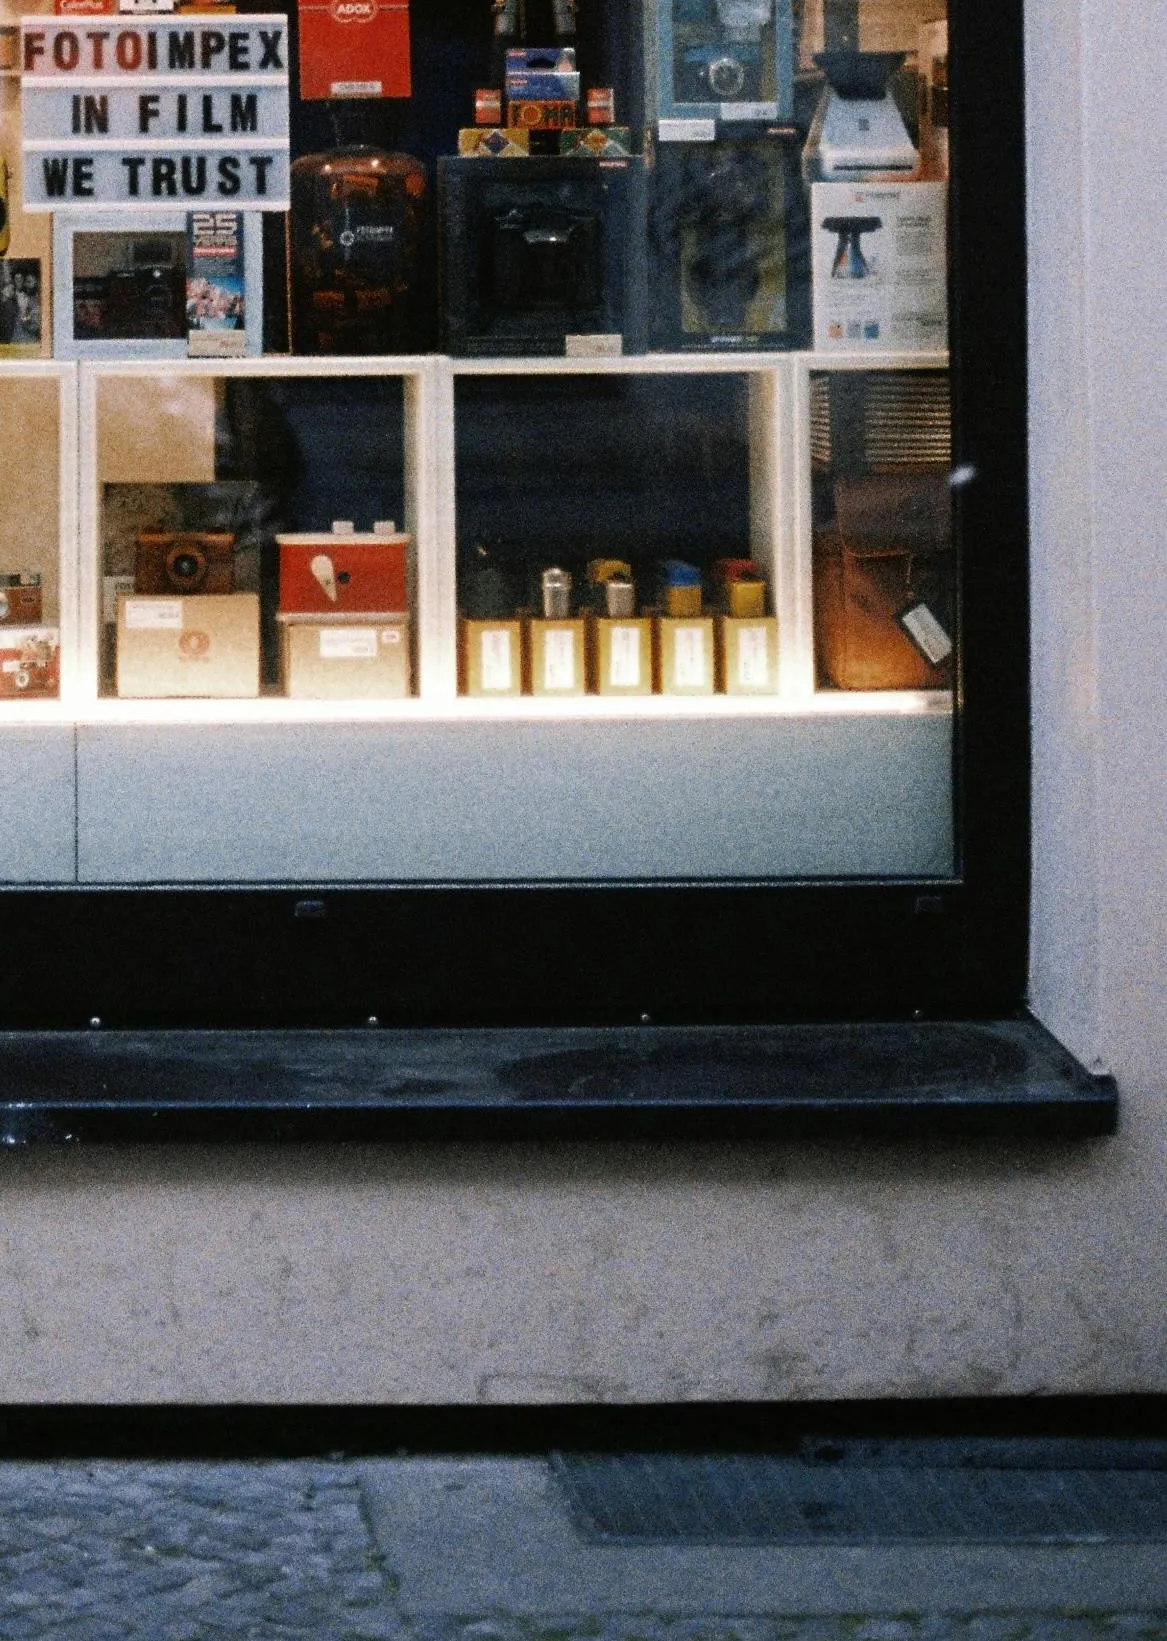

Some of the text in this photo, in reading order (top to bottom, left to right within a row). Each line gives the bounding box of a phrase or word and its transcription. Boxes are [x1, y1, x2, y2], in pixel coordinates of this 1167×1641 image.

[336, 2, 372, 15] ADOX
[22, 29, 284, 72] FOTOIMPEX
[70, 92, 259, 135] IN FILM
[42, 154, 274, 198] WE TRUST
